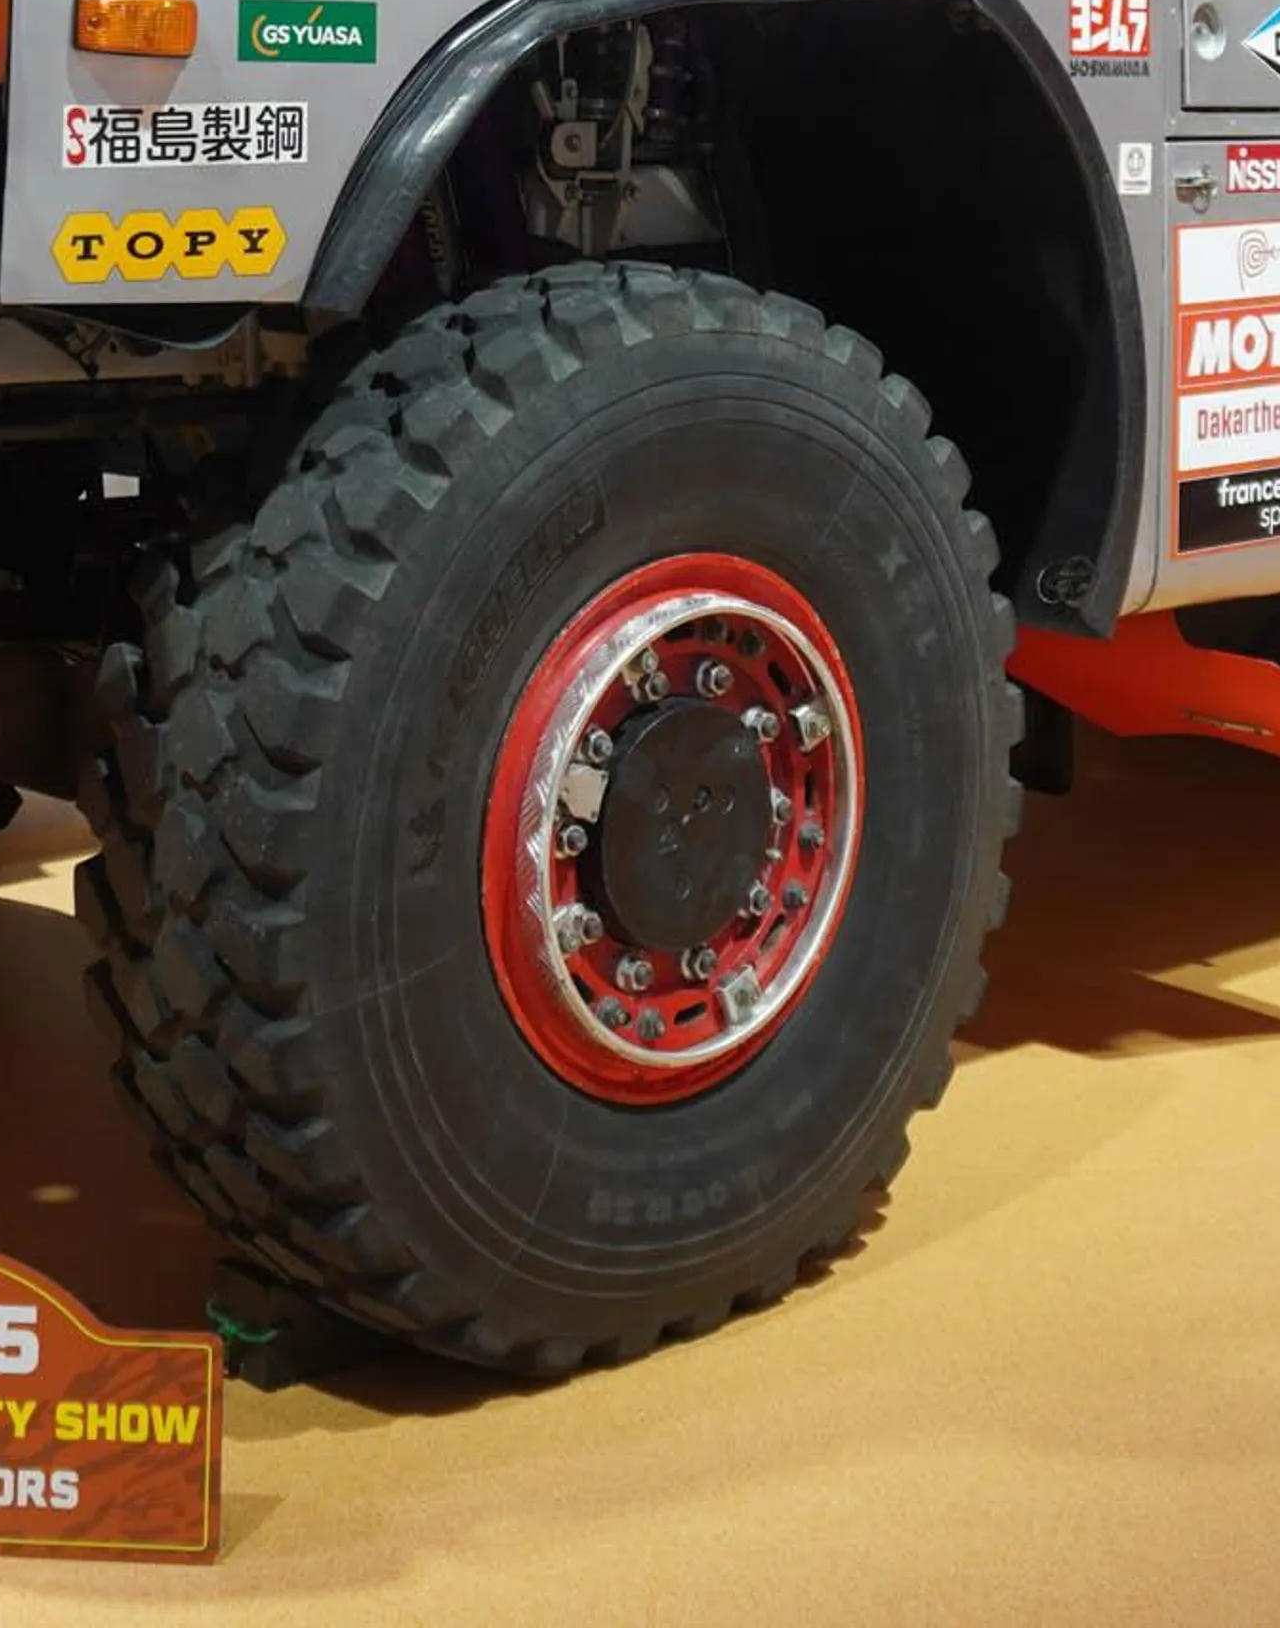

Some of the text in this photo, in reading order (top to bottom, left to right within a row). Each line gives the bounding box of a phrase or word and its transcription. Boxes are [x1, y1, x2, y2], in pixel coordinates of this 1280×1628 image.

[261, 24, 363, 47] GS YUASA
[89, 105, 305, 165] 福島製鋼
[70, 227, 271, 262] TOPY
[54, 1400, 200, 1446] SHOW
